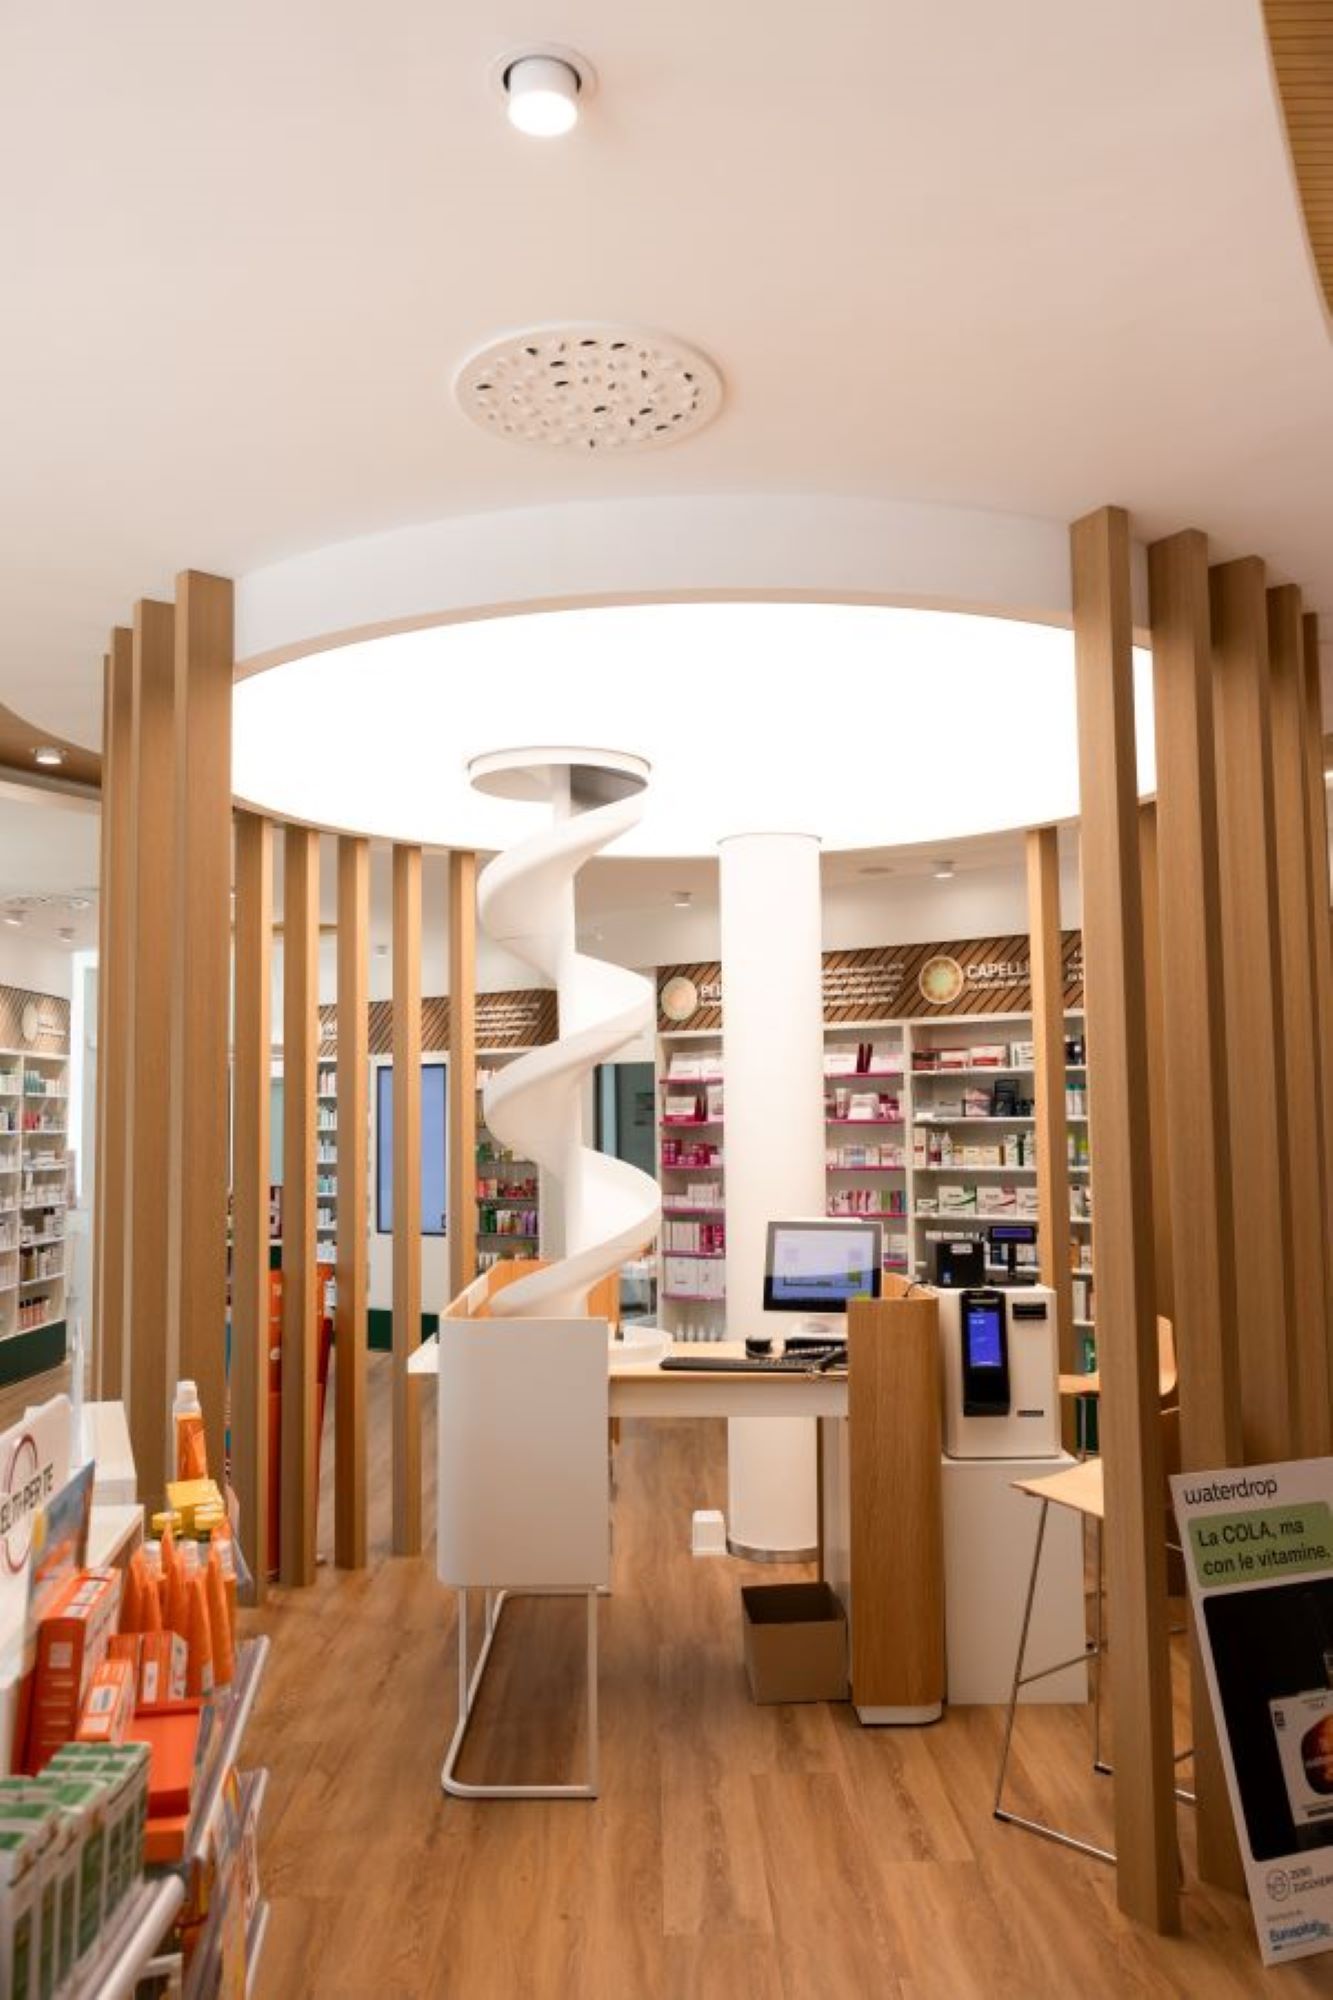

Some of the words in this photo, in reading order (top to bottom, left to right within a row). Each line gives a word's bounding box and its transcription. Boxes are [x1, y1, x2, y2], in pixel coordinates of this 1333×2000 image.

[1184, 1477, 1278, 1504] waterdrop
[1198, 1530, 1219, 1547] La
[1222, 1521, 1277, 1544] COLA,
[1280, 1520, 1305, 1534] ma
[1203, 1559, 1235, 1576] con
[1238, 1552, 1253, 1570] le
[1258, 1543, 1330, 1567] vitamine.
